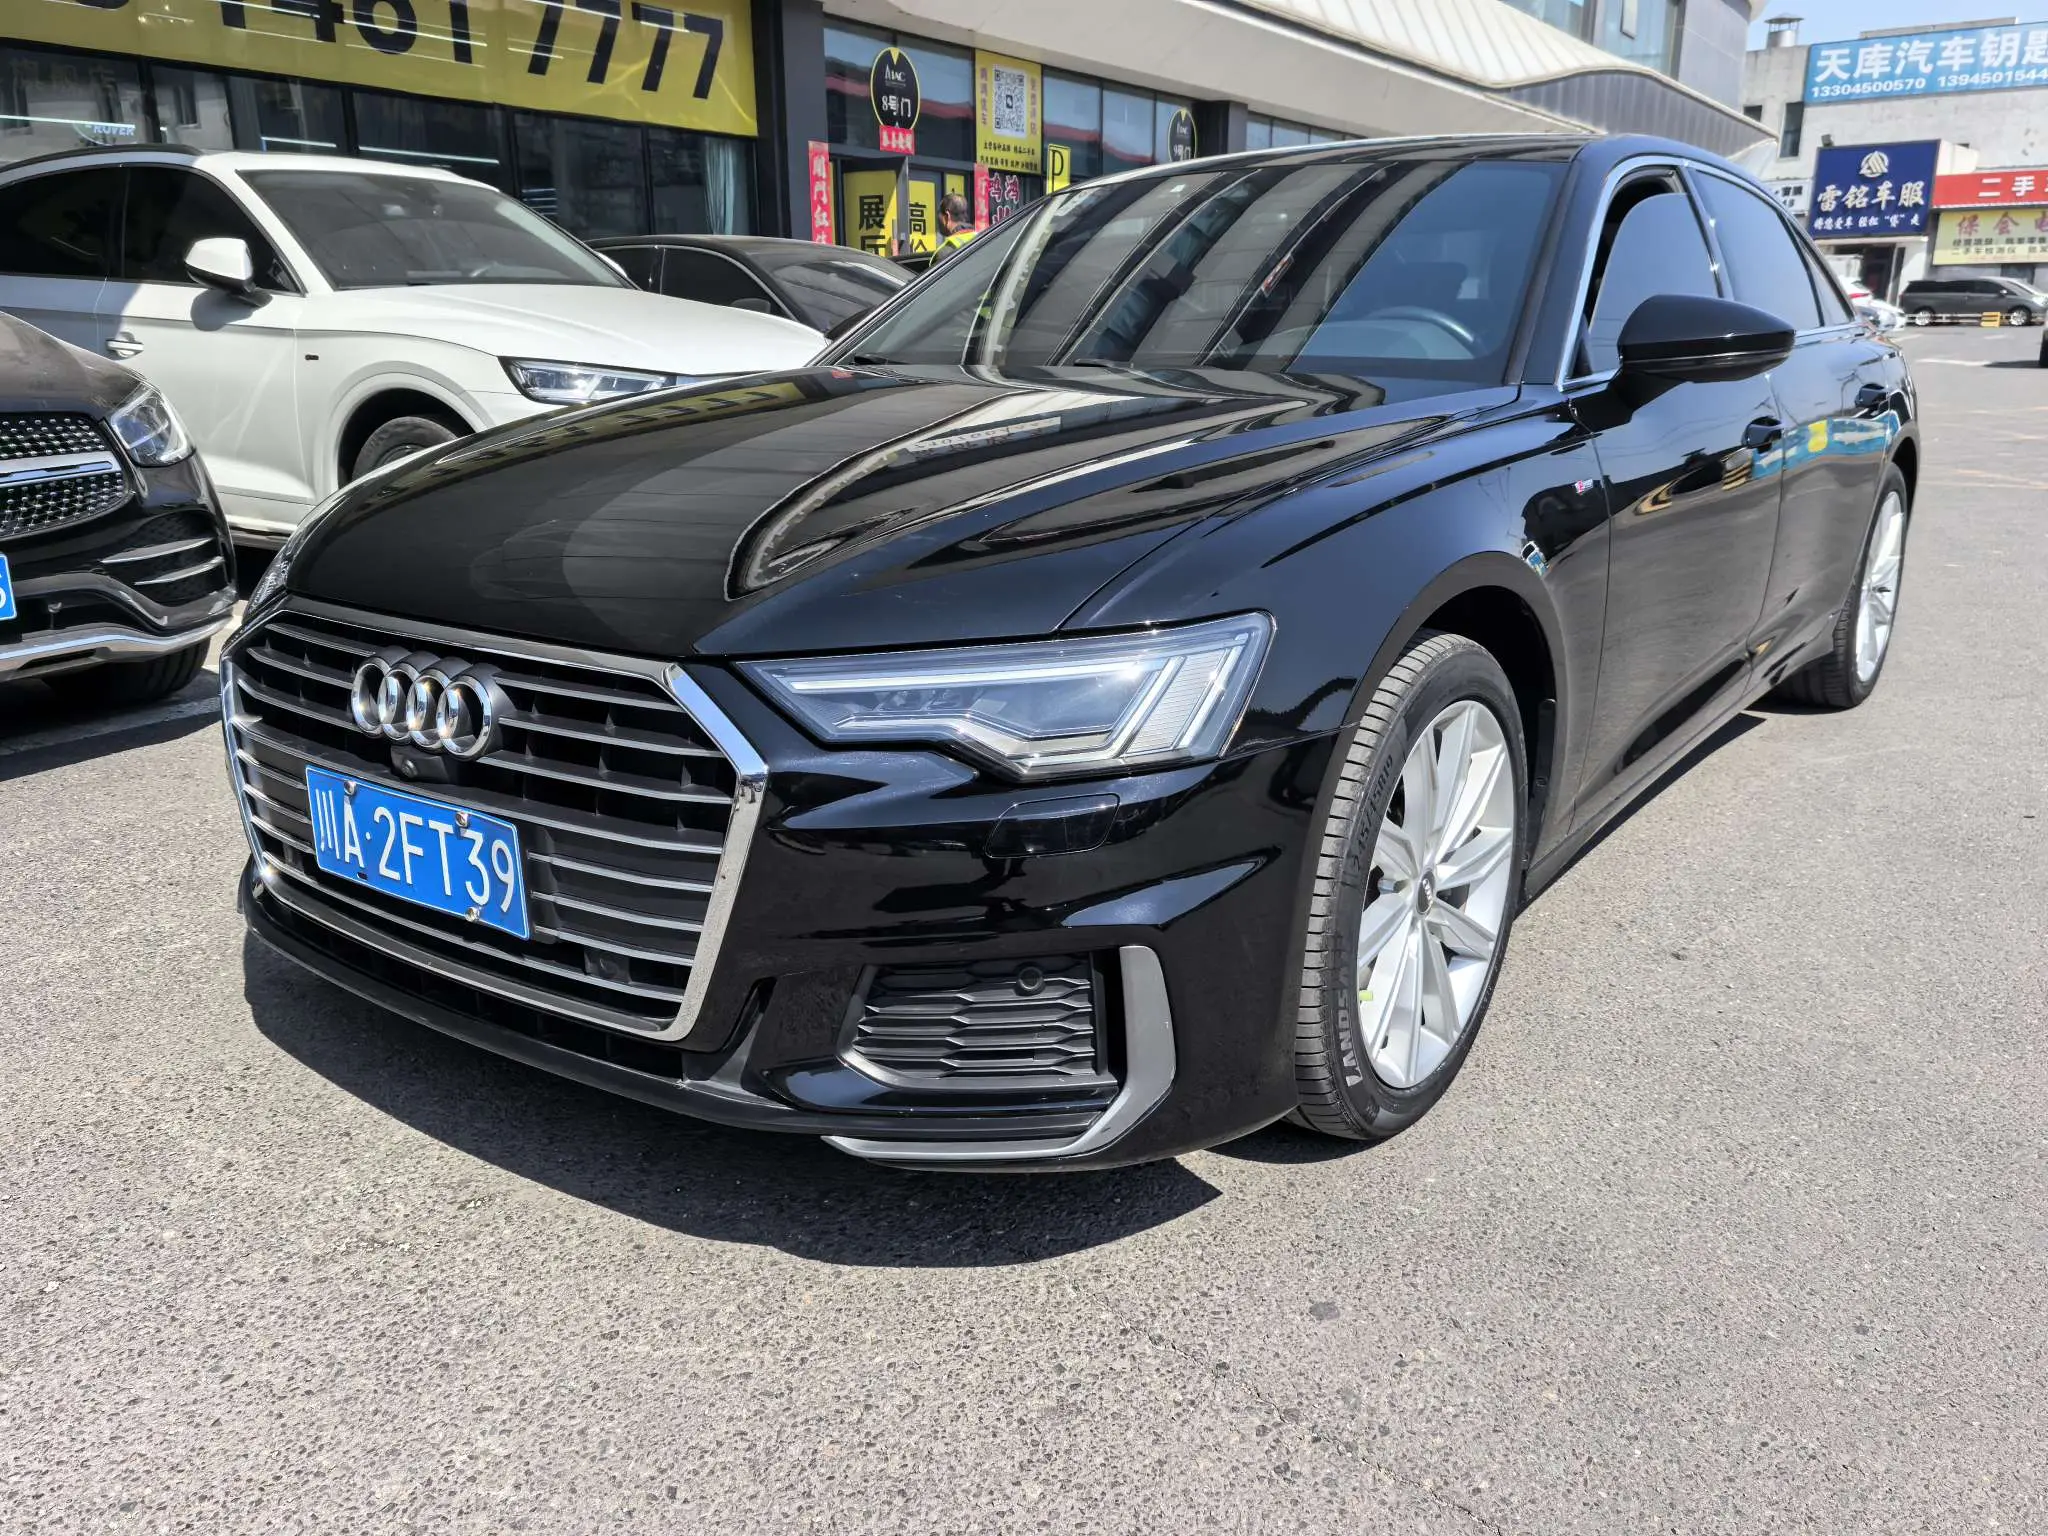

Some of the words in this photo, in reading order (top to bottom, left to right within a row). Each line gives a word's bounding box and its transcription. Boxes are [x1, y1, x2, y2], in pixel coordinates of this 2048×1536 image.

[1812, 78, 1926, 97] 13304500570
[882, 95, 911, 118] 8号门
[1052, 150, 1064, 192] P
[1818, 180, 1925, 212] 雷铭车服
